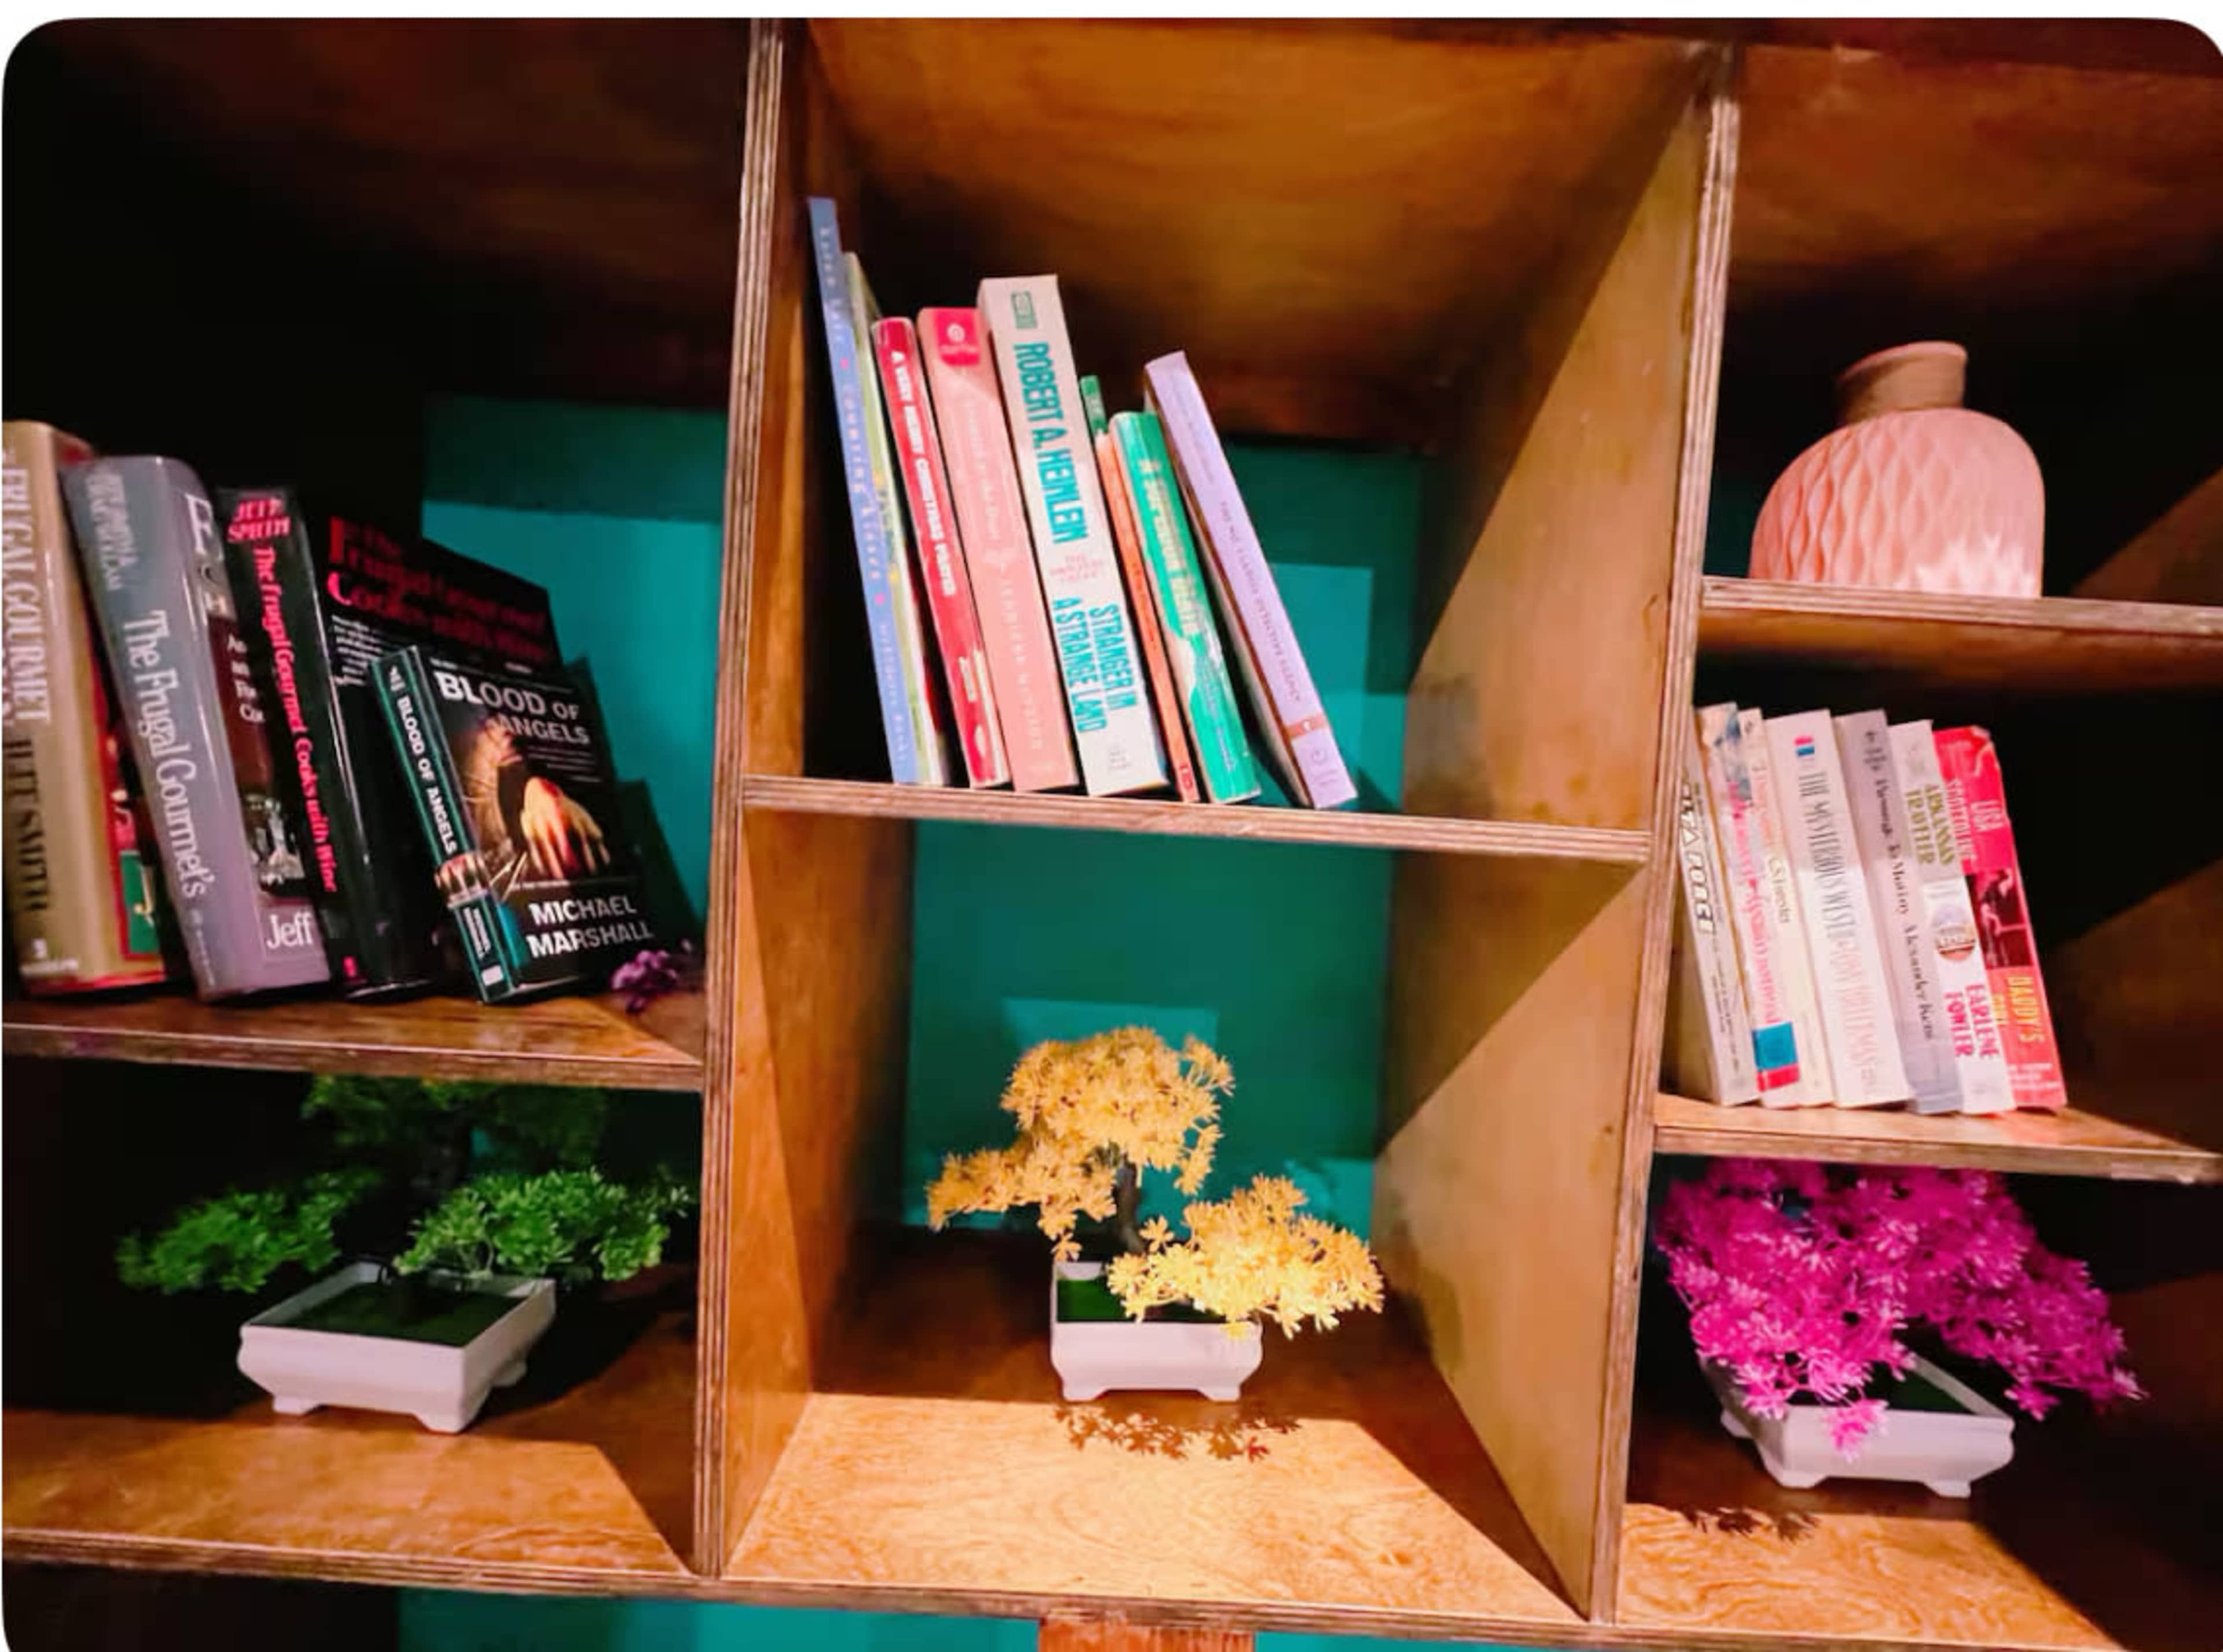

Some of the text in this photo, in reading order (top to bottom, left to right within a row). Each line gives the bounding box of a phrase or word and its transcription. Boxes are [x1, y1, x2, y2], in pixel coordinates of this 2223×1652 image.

[891, 351, 905, 364] A
[895, 366, 914, 402] VERY
[1013, 342, 1064, 422] ROBERT
[1032, 427, 1068, 449] A.
[914, 456, 945, 541] CHRISTMAS
[1036, 447, 1089, 544] HEINLEIN
[1053, 597, 1082, 610] A
[4, 581, 50, 721] GOURMET
[123, 610, 170, 668] The
[1055, 610, 1099, 687] STRANGE
[1088, 603, 1135, 691] STRANGER
[134, 668, 191, 759] Frugal
[254, 546, 338, 892] The Frugal Gourmet Cooks with Wine
[435, 671, 546, 715] BLOOD
[552, 702, 579, 719] OF
[1071, 689, 1108, 733] LAND
[1105, 692, 1138, 711] IN
[496, 714, 590, 744] ANGELS
[398, 695, 425, 754] BLOOD
[417, 758, 435, 781] OF
[426, 787, 457, 855] ANGELS
[1798, 772, 1830, 797] THE
[156, 758, 215, 898] Gourmet's
[1804, 800, 1846, 879] MYSTERIOUS
[266, 912, 313, 949] Jeff
[526, 922, 655, 958] MARSHALL
[527, 895, 637, 926] MICHAEL
[1944, 991, 1975, 1057] FOWLER
[1966, 984, 2000, 1059] EARLENE
[2006, 976, 2045, 1043] DADDY'S
